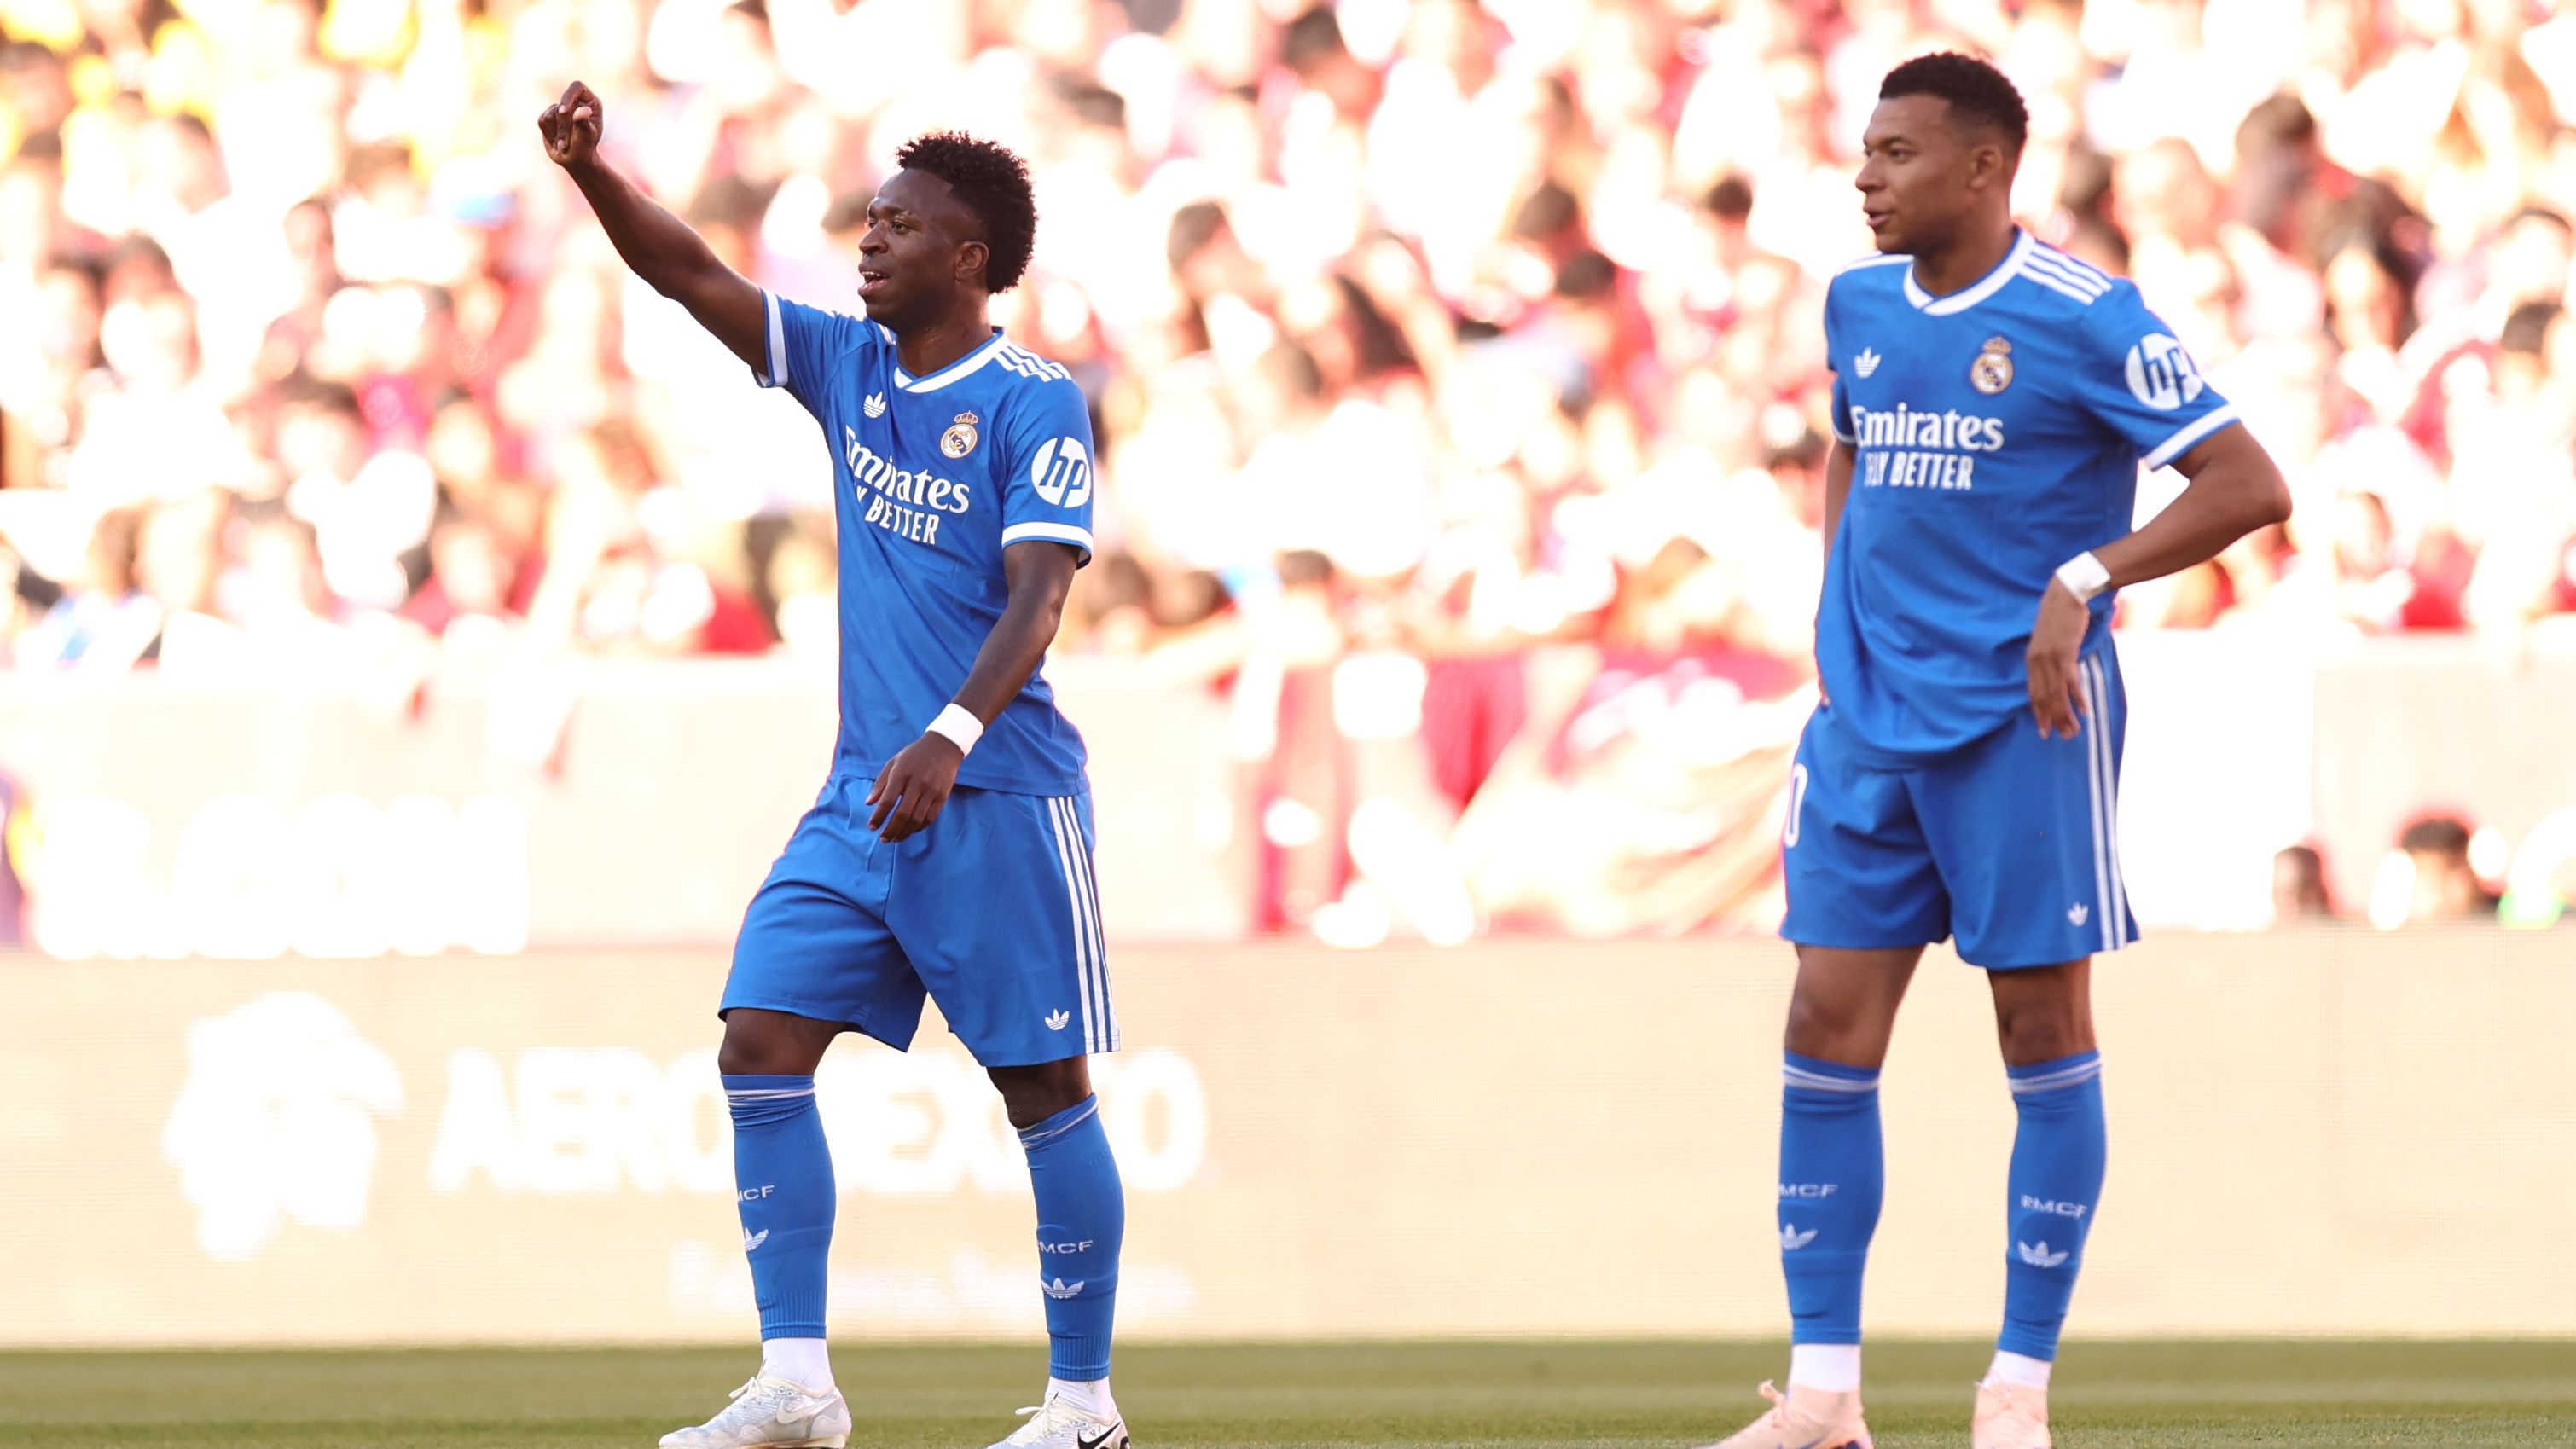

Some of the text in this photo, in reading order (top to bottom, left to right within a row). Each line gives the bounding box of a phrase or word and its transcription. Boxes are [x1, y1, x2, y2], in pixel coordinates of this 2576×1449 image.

[2127, 333, 2202, 409] hp
[1850, 402, 2005, 452] Emirates
[1034, 436, 1090, 508] hp
[1889, 450, 1974, 490] BETTER
[864, 494, 940, 544] BETTER
[426, 1046, 1205, 1195] AEROEXO
[2020, 1194, 2088, 1219] RMCF
